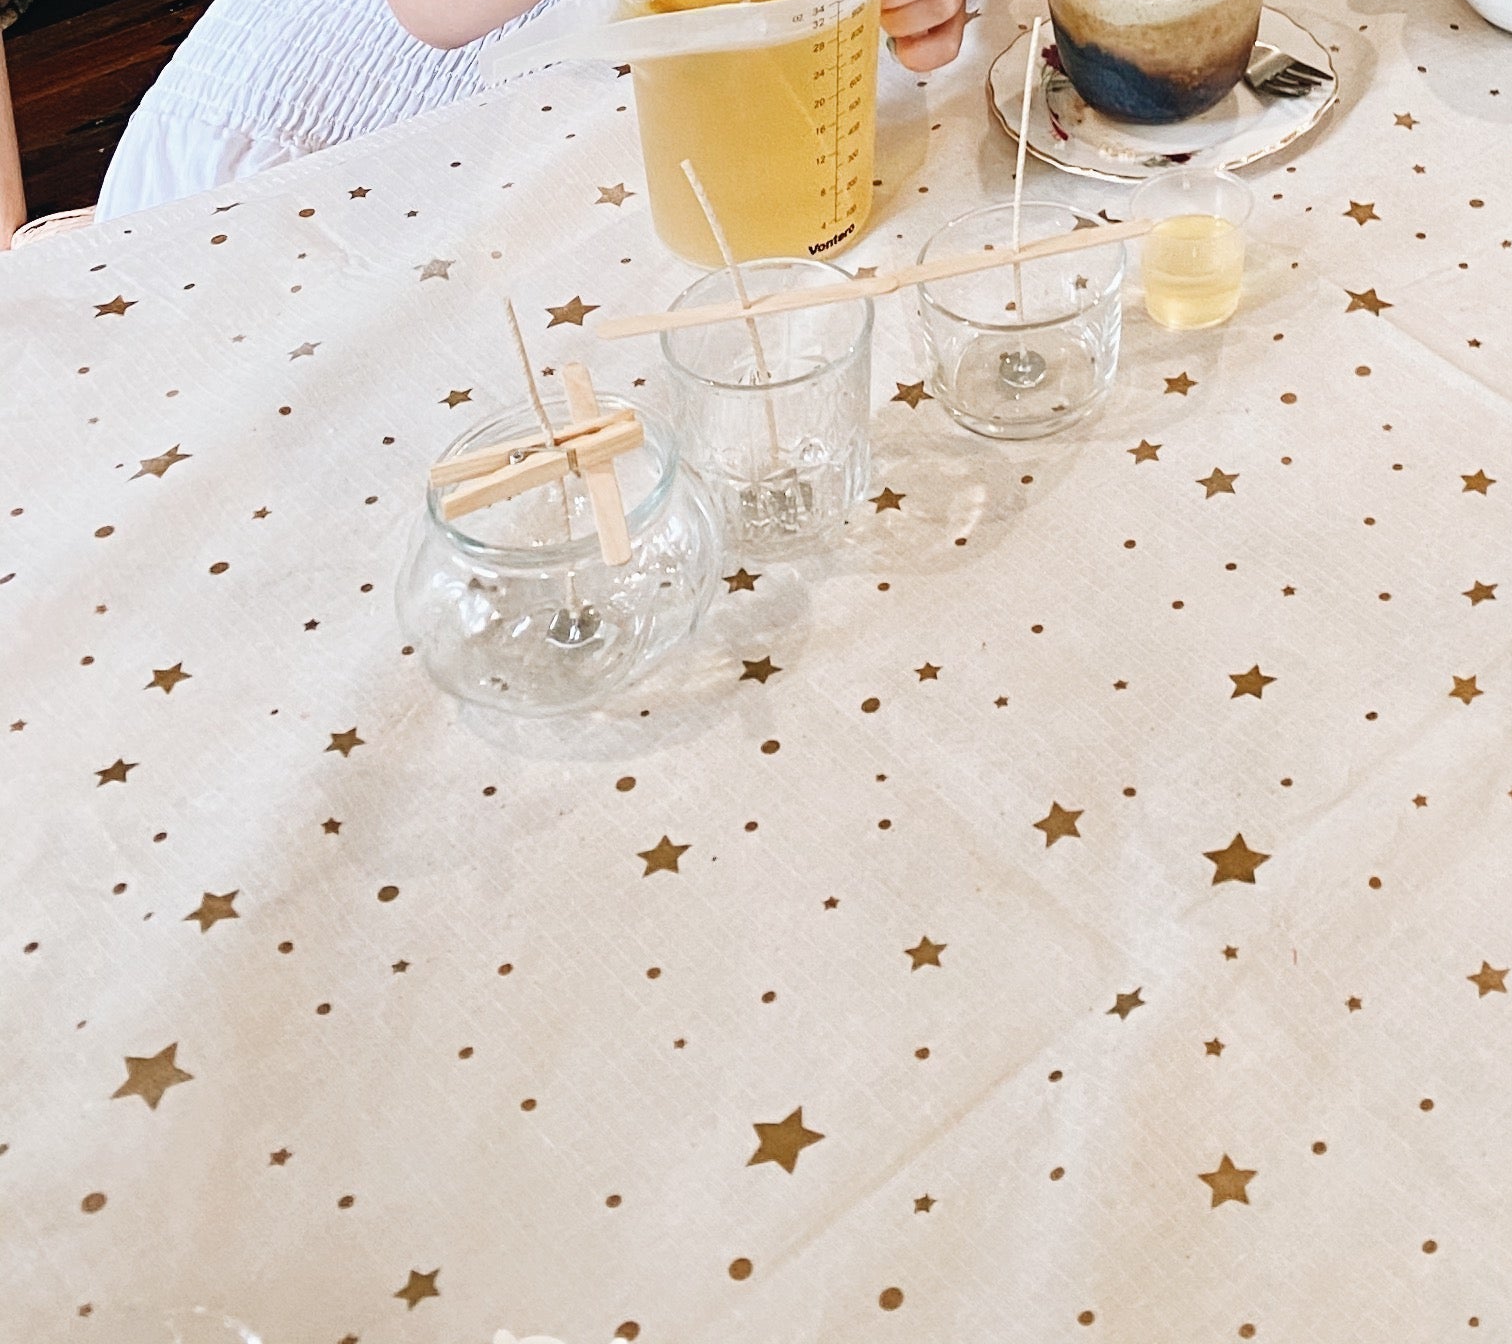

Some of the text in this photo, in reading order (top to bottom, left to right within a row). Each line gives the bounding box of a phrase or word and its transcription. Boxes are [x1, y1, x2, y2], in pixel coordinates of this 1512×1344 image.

[814, 98, 825, 109] 20
[816, 124, 826, 136] 16
[816, 155, 826, 165] 12
